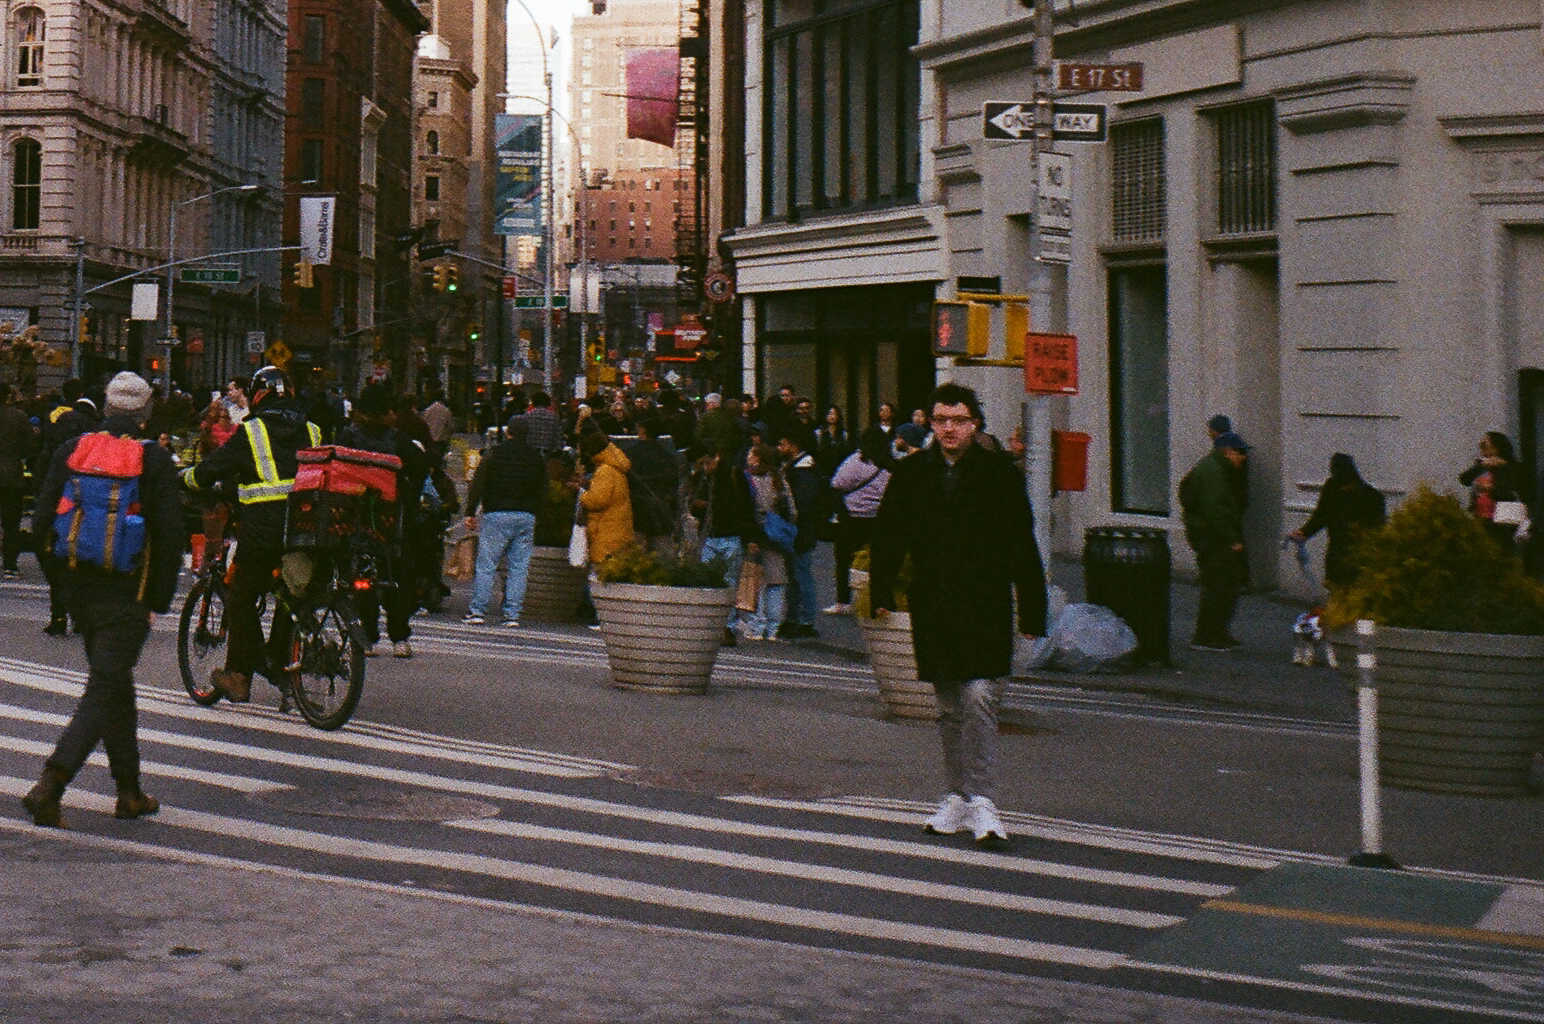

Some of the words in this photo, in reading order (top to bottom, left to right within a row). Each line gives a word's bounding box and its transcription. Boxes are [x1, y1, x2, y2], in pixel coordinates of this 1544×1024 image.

[1071, 68, 1081, 87] E
[1088, 68, 1105, 87] 17
[1112, 69, 1131, 87] St
[1059, 114, 1093, 129] WAY
